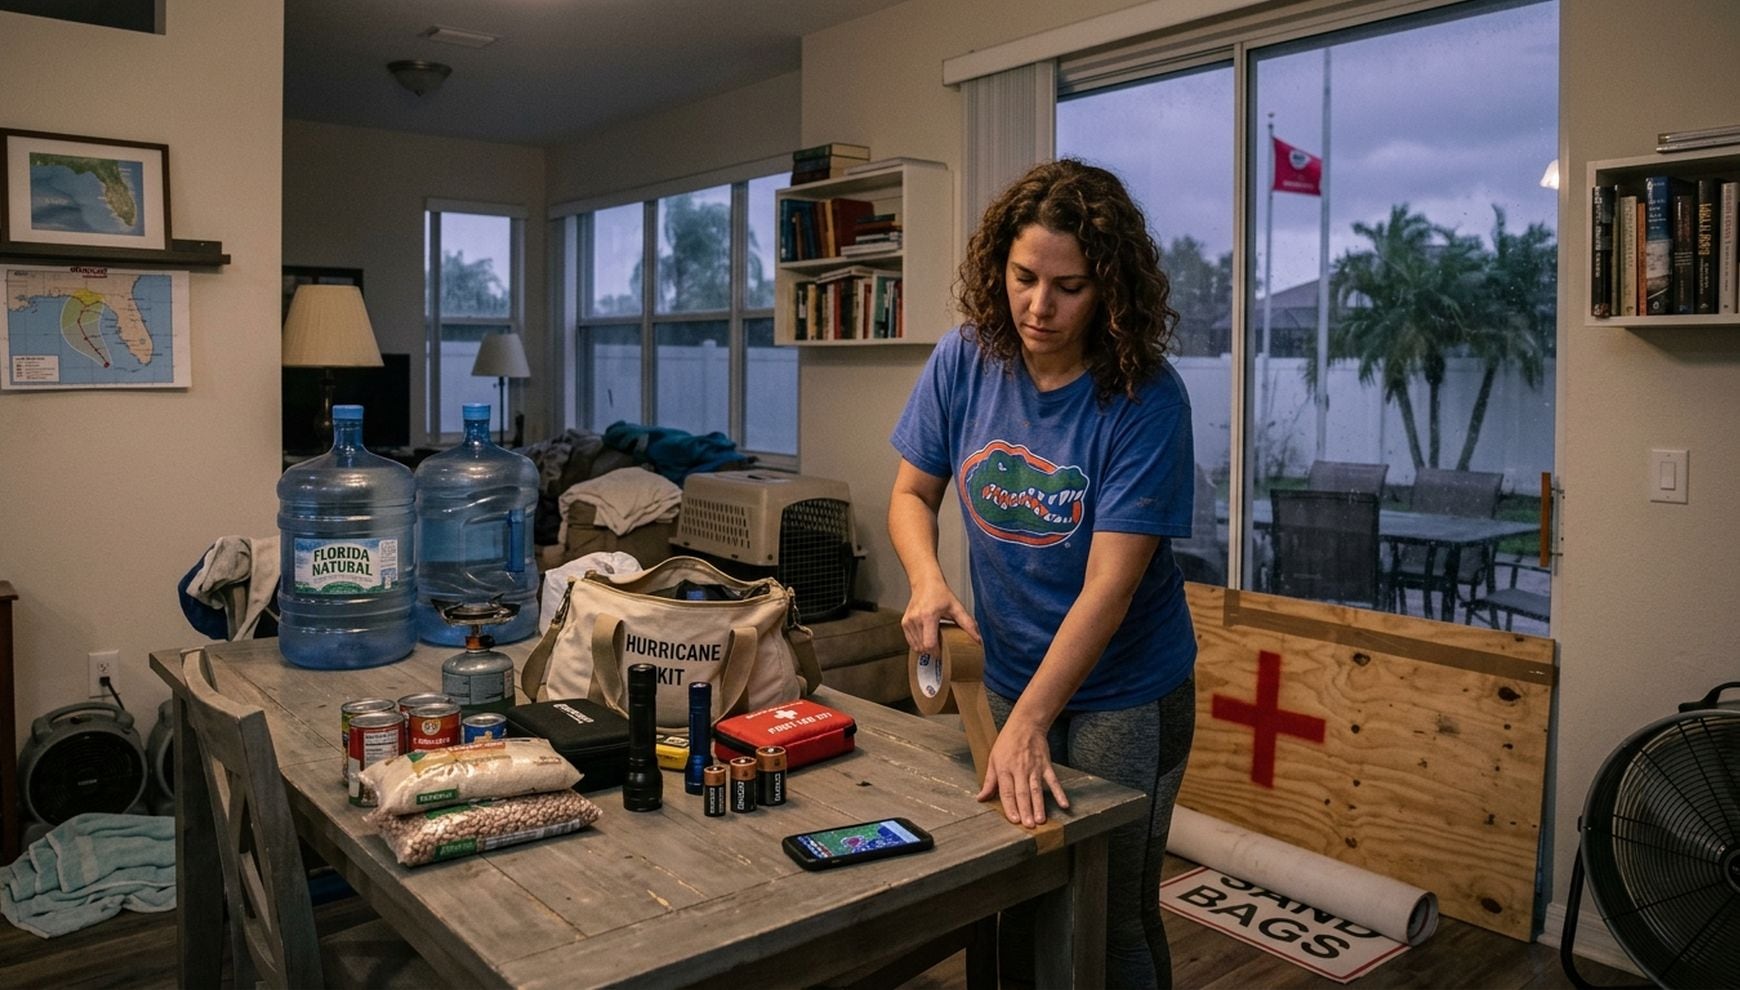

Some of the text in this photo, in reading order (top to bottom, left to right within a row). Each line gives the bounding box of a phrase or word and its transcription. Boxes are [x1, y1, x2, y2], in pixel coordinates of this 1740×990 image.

[313, 546, 370, 562] FLORIDA
[312, 560, 373, 576] NATURAL
[626, 634, 721, 662] HURRICANE
[657, 667, 685, 686] KIT
[1176, 884, 1351, 959] BAGS
